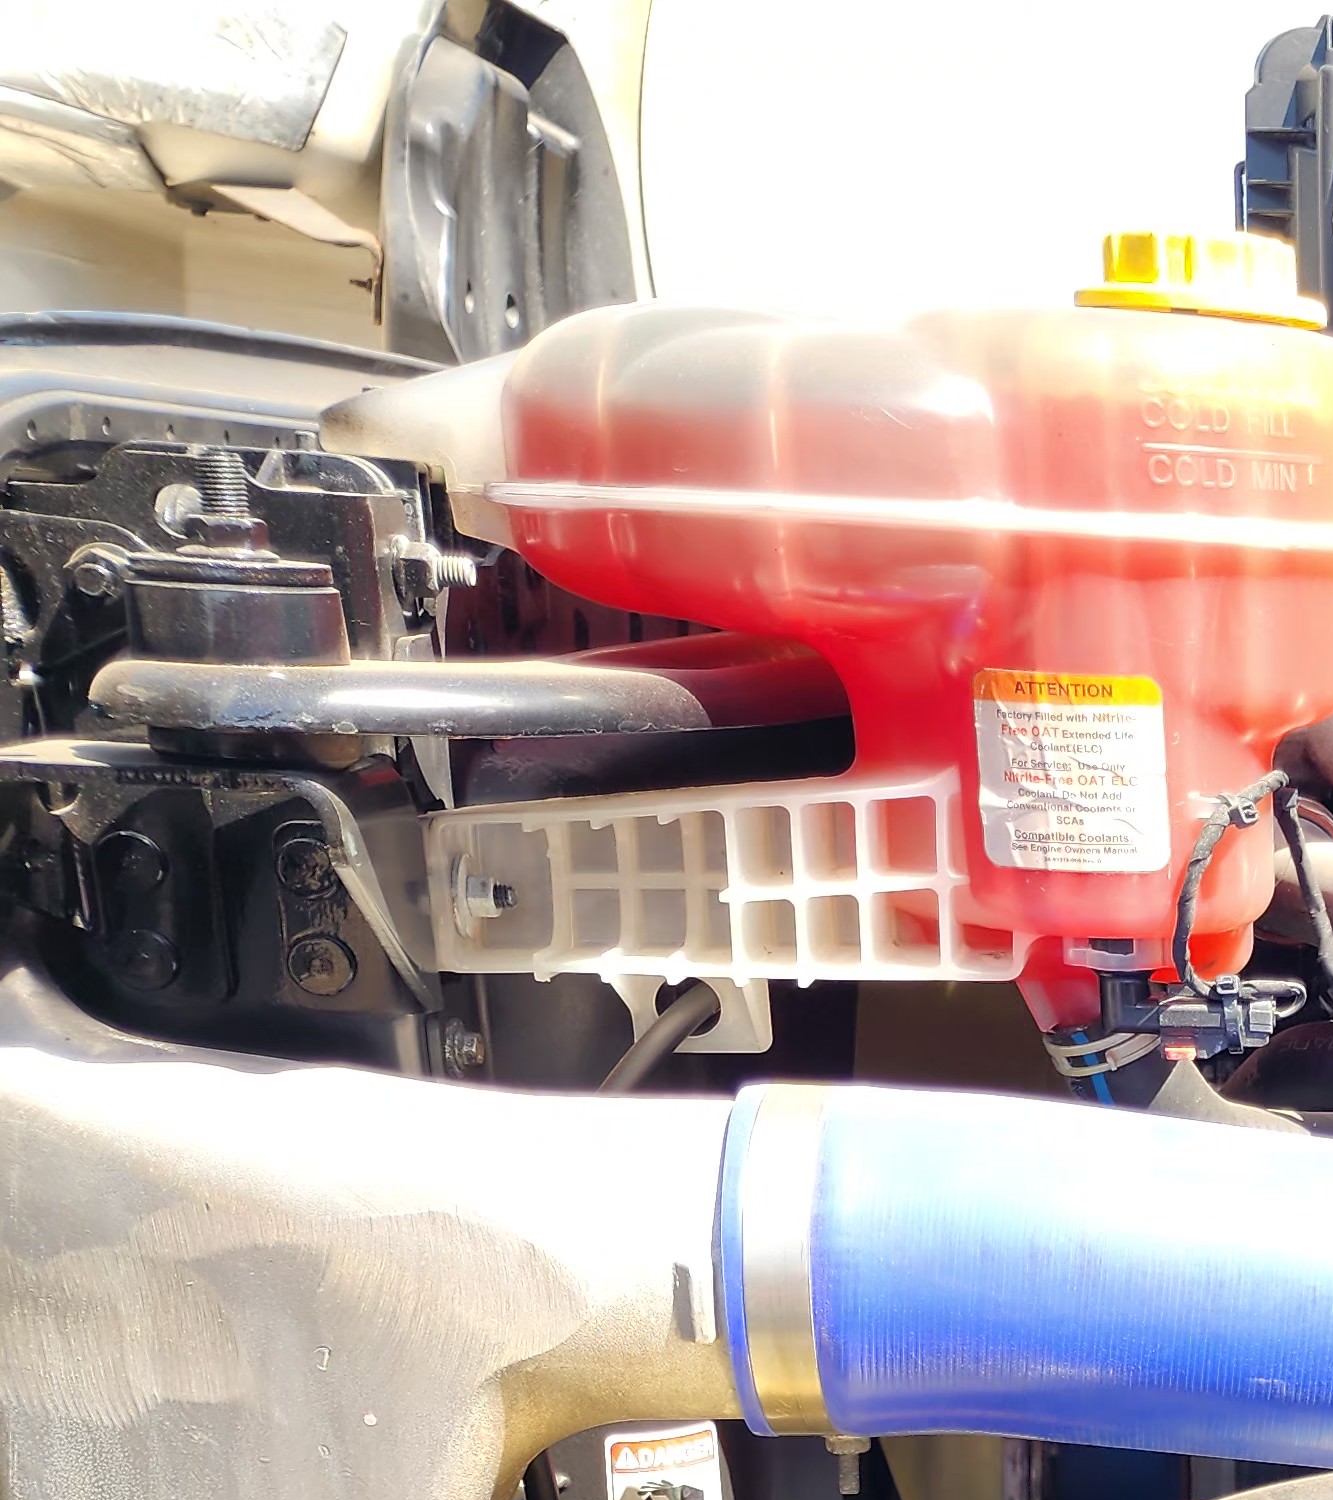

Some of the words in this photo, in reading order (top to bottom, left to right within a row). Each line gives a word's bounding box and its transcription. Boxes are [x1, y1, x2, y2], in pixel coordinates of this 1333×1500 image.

[1140, 398, 1230, 432] COLD
[1248, 410, 1295, 437] FILL
[1149, 454, 1235, 489] COLD
[1251, 461, 1297, 492] MIN
[1015, 681, 1113, 697] ATTENTION
[997, 710, 1032, 722] Factory
[1035, 711, 1063, 722] Filled
[1066, 713, 1088, 723] with
[1002, 724, 1028, 736] Free
[1032, 726, 1060, 737] OAT
[1062, 730, 1111, 740] Extended
[1115, 732, 1133, 740] Life
[1012, 759, 1027, 769] For
[1030, 759, 1072, 771] Service:
[1078, 762, 1098, 770] Use
[1101, 763, 1125, 773] Only
[1004, 771, 1073, 785] Nitrite-Free
[1078, 775, 1106, 785] OAT
[1112, 776, 1137, 786] ELC
[1062, 791, 1074, 800] Do
[1080, 792, 1098, 800] Not
[1101, 792, 1122, 800] Add
[1007, 801, 1072, 812] Conventional
[1075, 804, 1121, 813] Coolants
[1057, 816, 1084, 826] SCAs
[1014, 829, 1074, 842] Compatible
[1012, 843, 1028, 851] See
[1031, 843, 1061, 854] Engine
[1064, 846, 1101, 854] Owners
[1103, 846, 1137, 855] Manual
